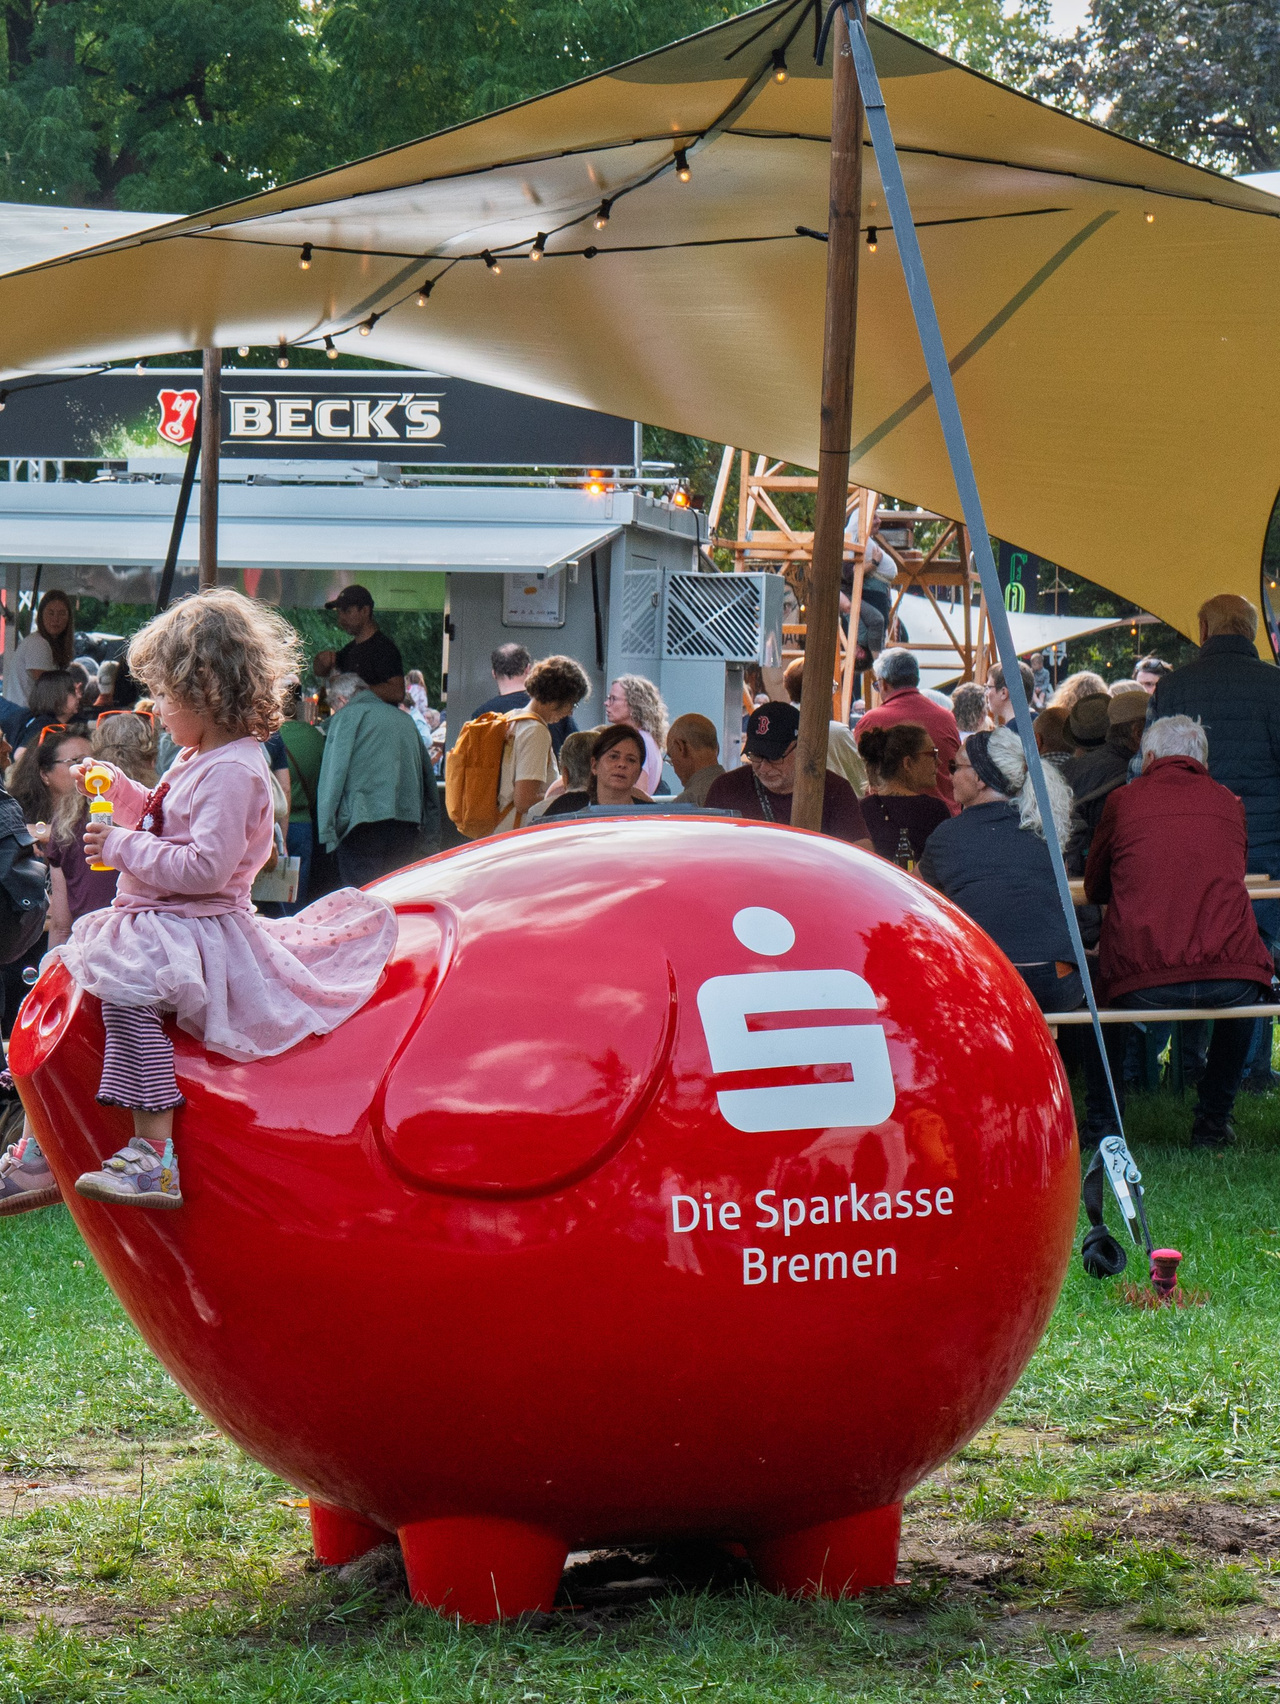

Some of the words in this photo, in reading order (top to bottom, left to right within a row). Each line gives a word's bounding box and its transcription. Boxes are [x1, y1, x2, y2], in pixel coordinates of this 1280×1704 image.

[229, 393, 441, 439] BECK'S
[755, 715, 770, 735] B
[670, 1192, 741, 1233] Die
[755, 1182, 954, 1237] Sparkasse
[742, 1245, 897, 1285] Bremen
